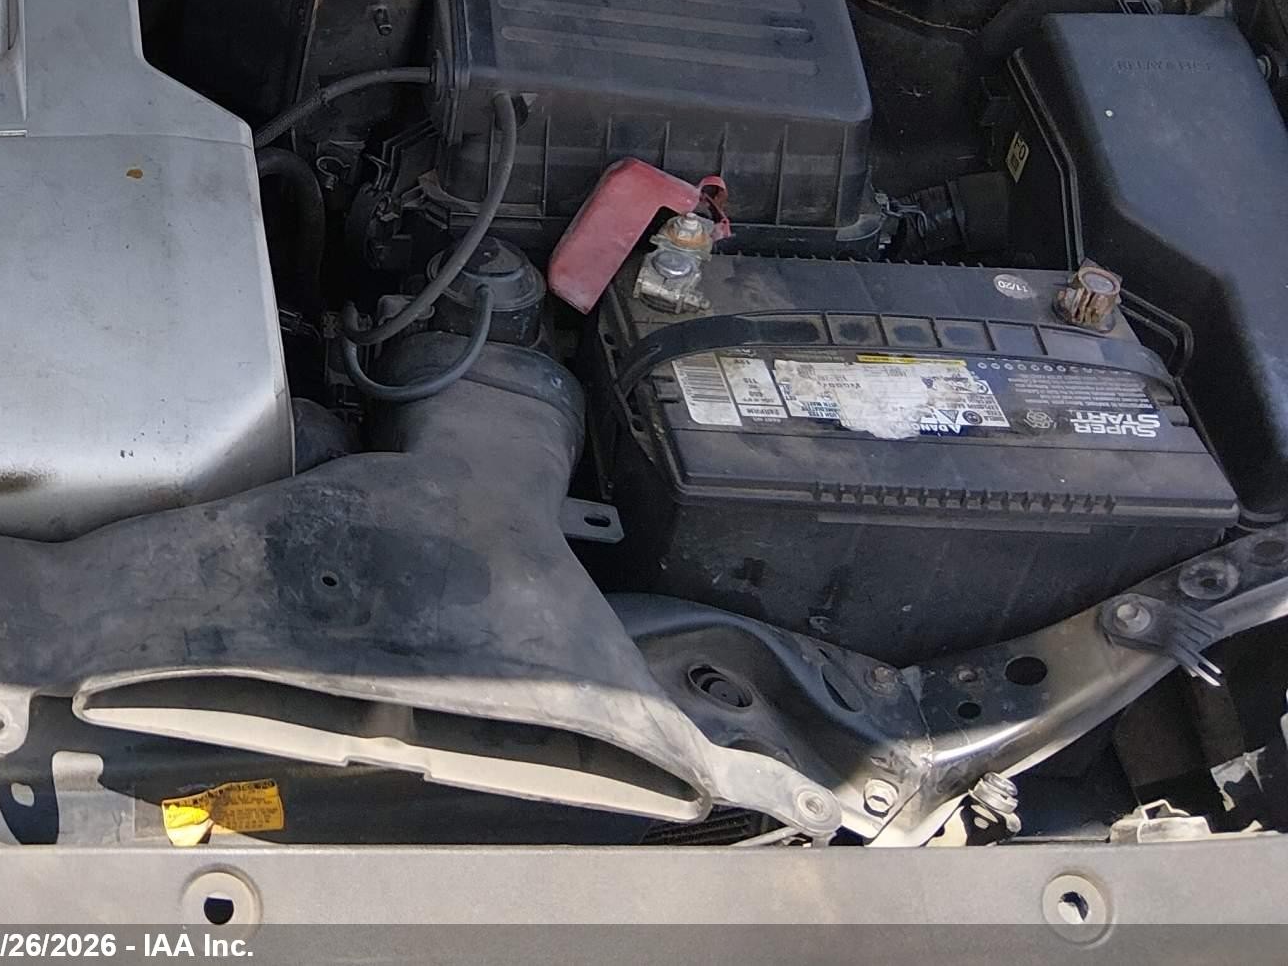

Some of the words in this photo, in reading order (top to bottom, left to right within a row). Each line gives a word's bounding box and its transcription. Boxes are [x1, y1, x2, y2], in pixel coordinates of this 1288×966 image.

[997, 280, 1029, 293] 11/20
[1069, 411, 1161, 428] START
[1073, 422, 1157, 437] SUPER
